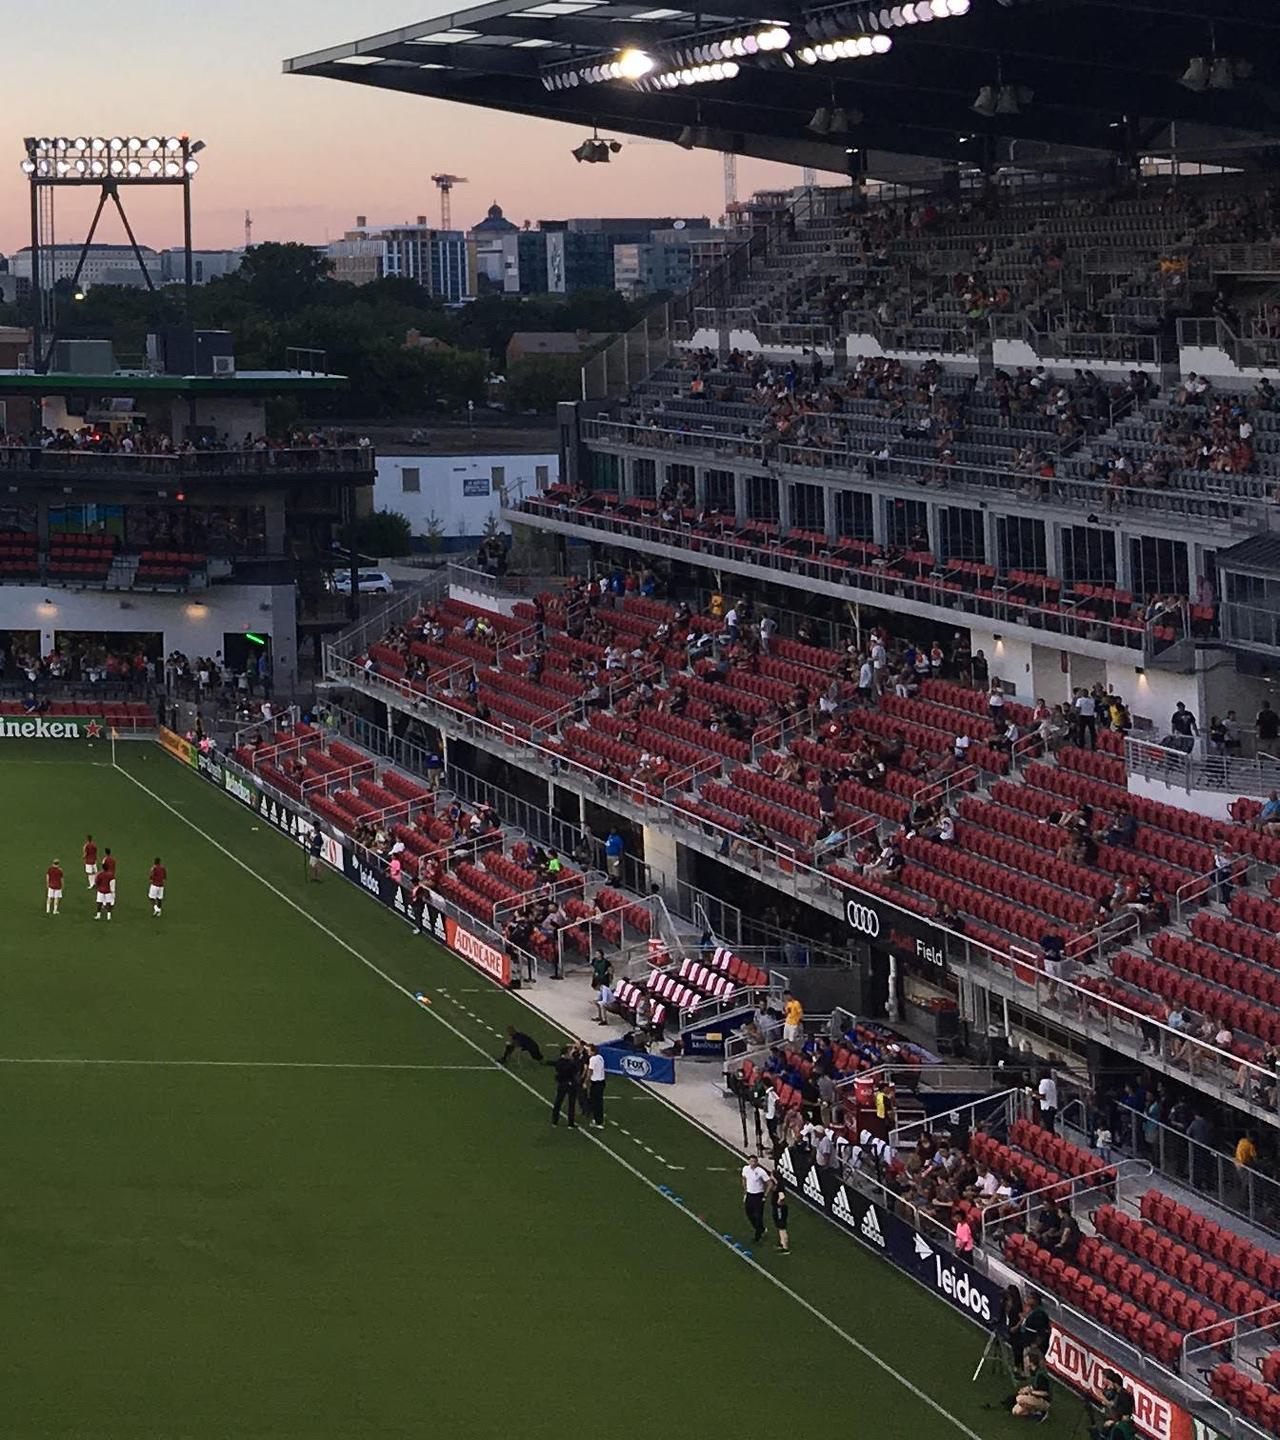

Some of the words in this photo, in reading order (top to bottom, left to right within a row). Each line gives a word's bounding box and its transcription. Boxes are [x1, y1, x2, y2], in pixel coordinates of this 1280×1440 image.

[359, 863, 380, 896] leidos
[456, 928, 502, 977] ADVOCARE
[916, 938, 943, 967] Field
[626, 1058, 645, 1071] FOX
[802, 1182, 825, 1207] adidas
[831, 1202, 856, 1227] adidas
[860, 1222, 886, 1248] adidas
[935, 1254, 991, 1321] leidos
[1050, 1334, 1169, 1436] ADVORE
